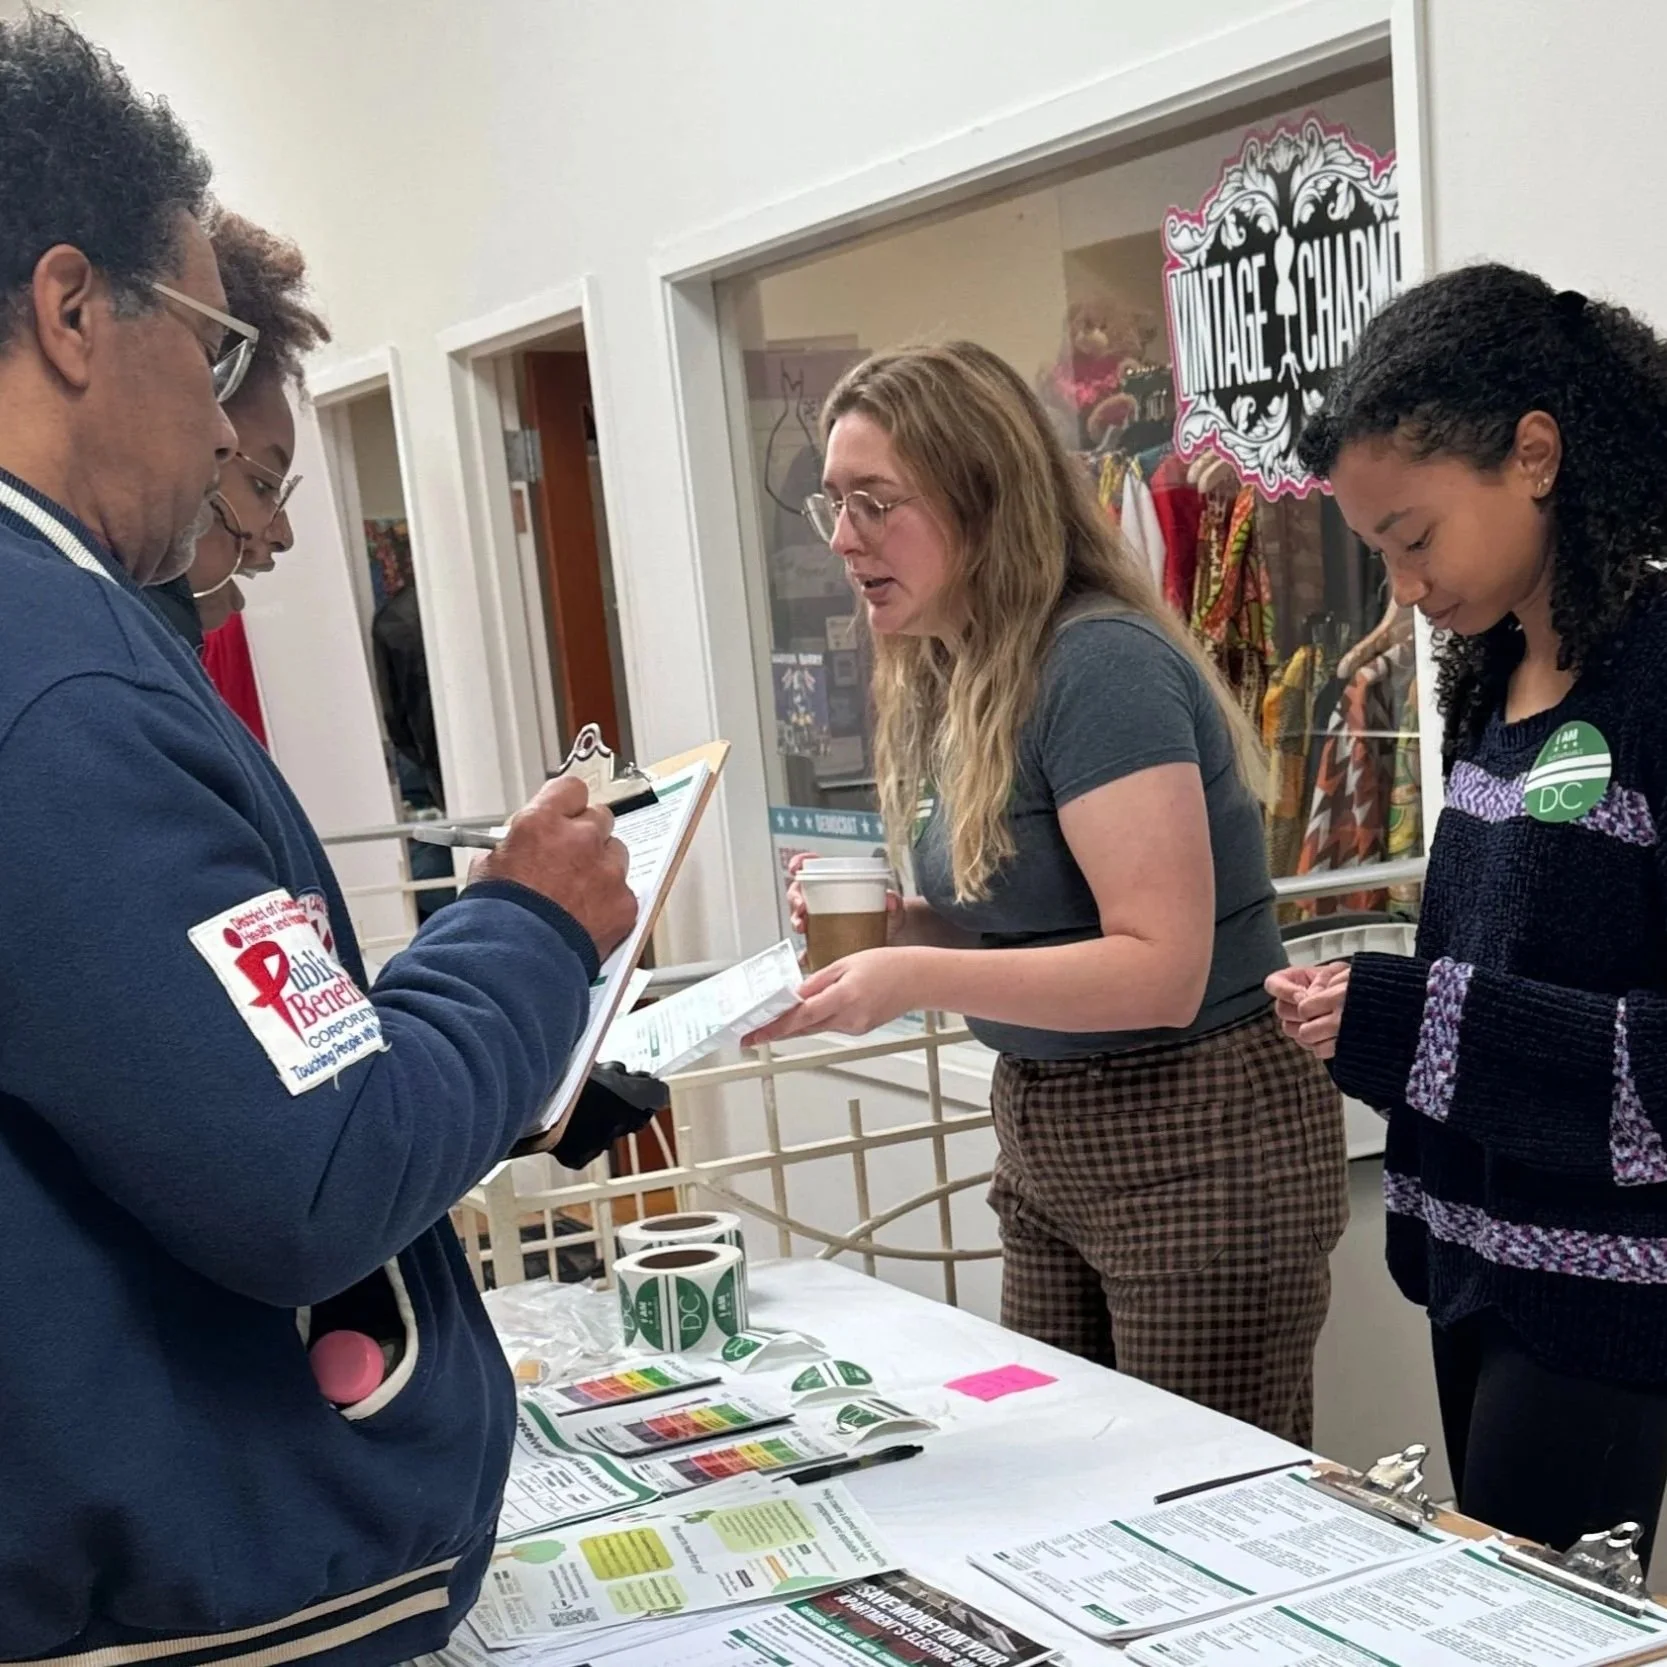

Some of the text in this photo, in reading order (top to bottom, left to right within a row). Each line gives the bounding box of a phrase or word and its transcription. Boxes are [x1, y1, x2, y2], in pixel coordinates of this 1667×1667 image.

[1169, 253, 1273, 397] VINTAGE
[1562, 728, 1579, 743] AM
[1539, 782, 1583, 813] DC
[680, 1294, 702, 1330] DC
[856, 1584, 1010, 1667] SAVE MONEY ON YOUR
[902, 1631, 961, 1663] ELECTRIC
